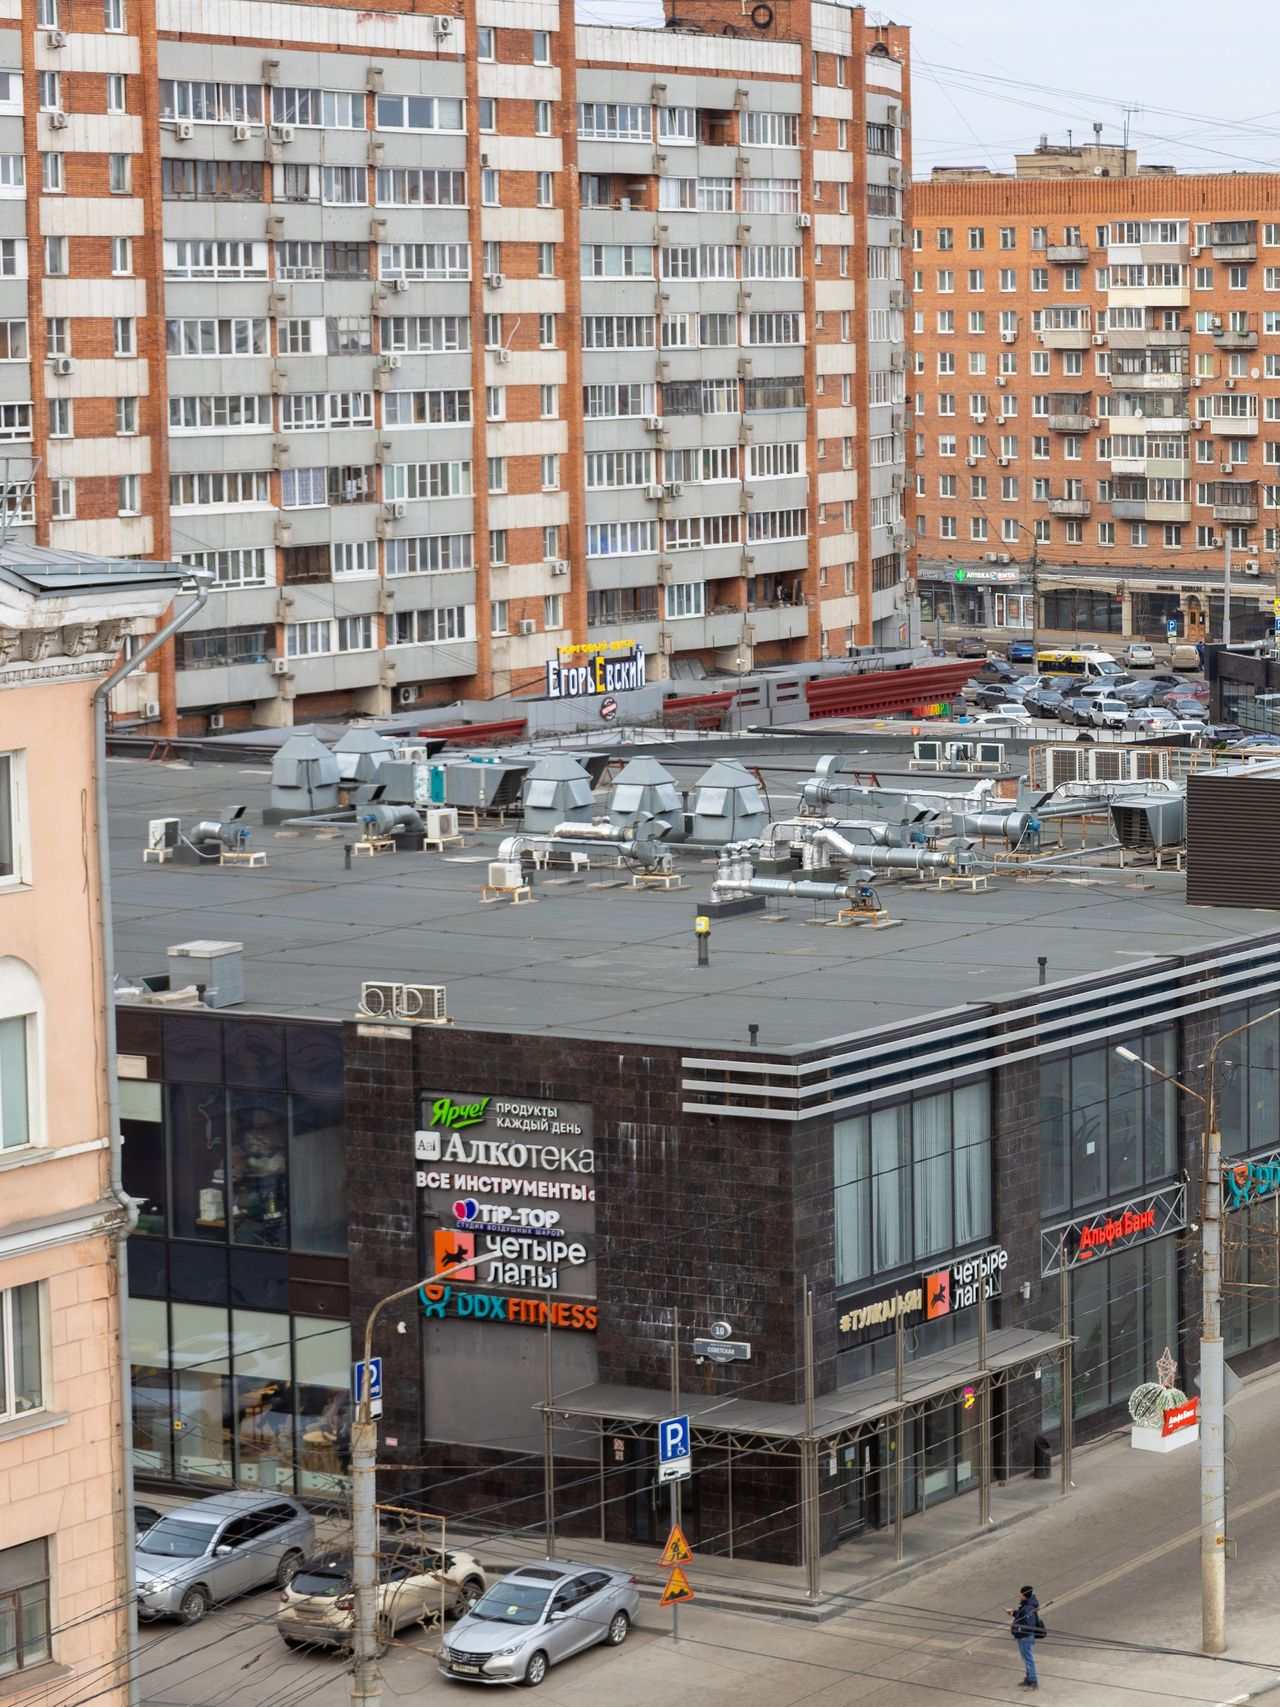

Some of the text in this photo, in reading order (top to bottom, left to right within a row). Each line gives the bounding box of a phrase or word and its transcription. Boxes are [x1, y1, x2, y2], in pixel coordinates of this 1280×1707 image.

[558, 639, 636, 654] ТОРГОВЫЙ ЦЕНТР
[430, 1098, 558, 1128] Ярче! ПРОДУКТЫ
[496, 1118, 582, 1135] КАЖДЫЙ ДЕНЬ
[442, 1132, 595, 1174] Алкотека
[416, 1170, 451, 1190] ВСЕ
[454, 1173, 588, 1202] ИНСТРУМЕНТЫ
[456, 1221, 562, 1238] СТУДИЯ ВОЗДУШНЫХ ШАРОВ
[1080, 1209, 1156, 1250] Альфа Банк
[487, 1261, 558, 1290] лапы
[457, 1292, 598, 1330] DDX FITNESS
[715, 1326, 725, 1336] 10
[707, 1346, 735, 1355] СОВЕТСКАЯ
[1168, 1413, 1184, 1425] Альфа
[666, 1423, 684, 1458] P
